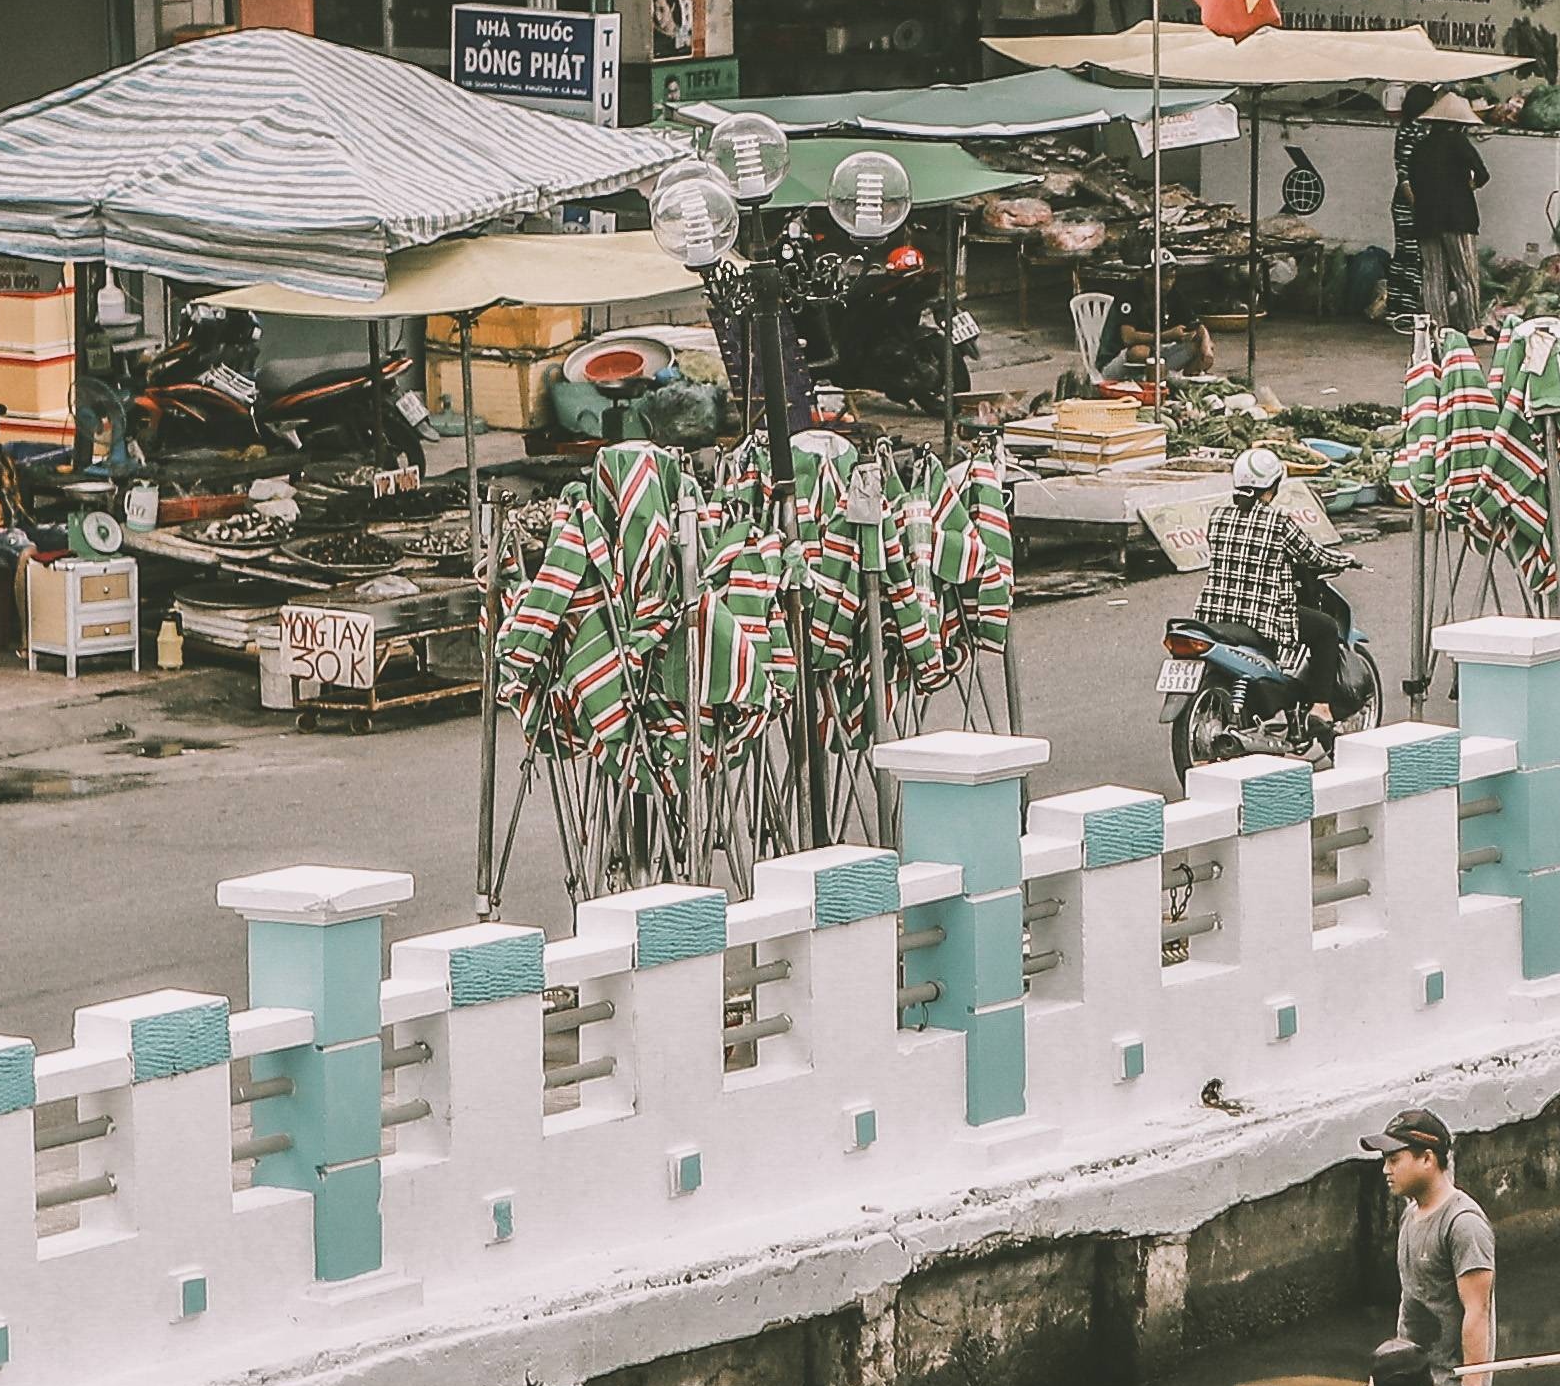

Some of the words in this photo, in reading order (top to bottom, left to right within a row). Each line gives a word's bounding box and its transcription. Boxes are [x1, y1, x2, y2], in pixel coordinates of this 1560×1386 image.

[476, 17, 511, 38] NHÀ
[517, 19, 574, 42] THUỐC
[464, 39, 522, 77] ĐỒNG
[530, 47, 586, 82] PHÁT
